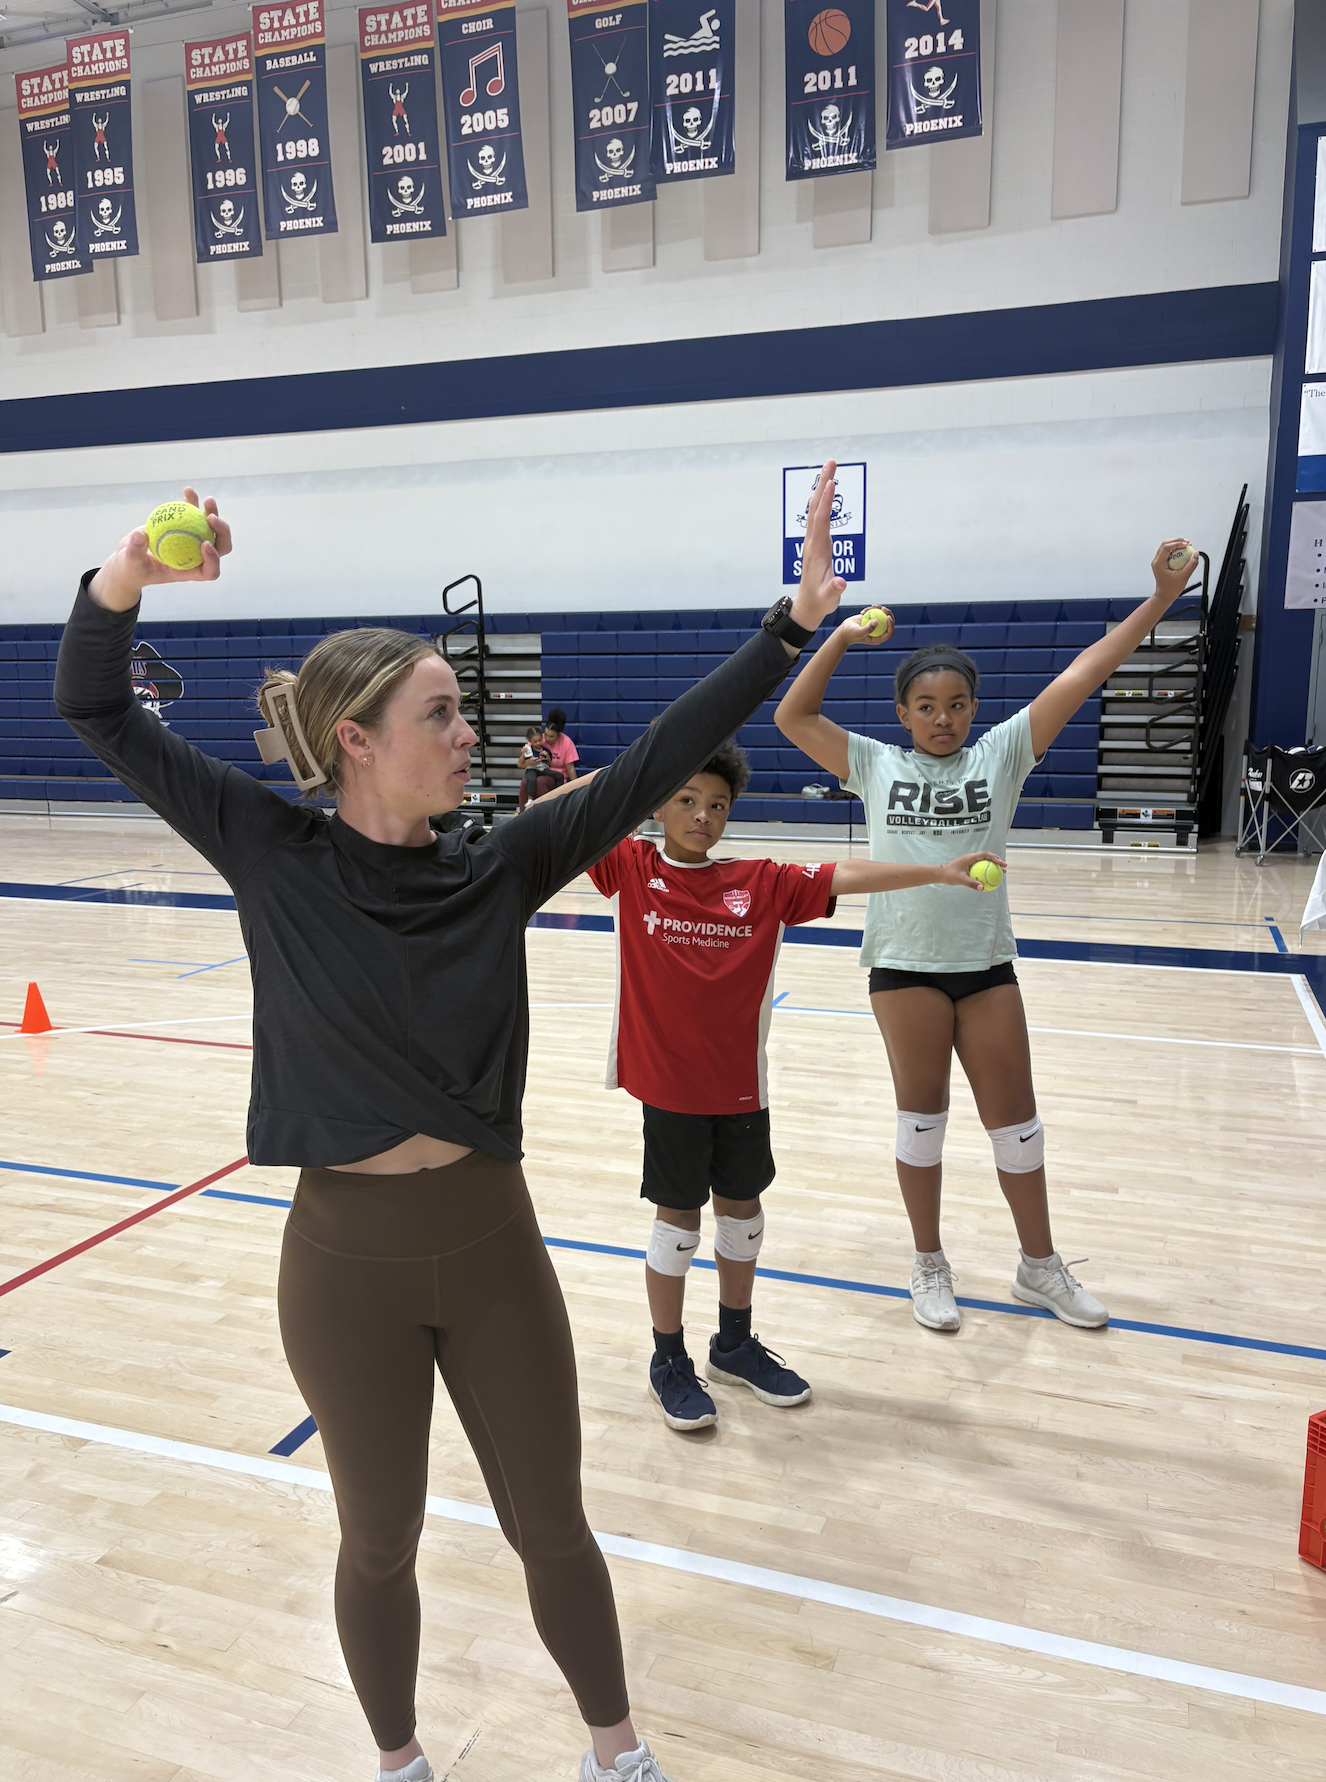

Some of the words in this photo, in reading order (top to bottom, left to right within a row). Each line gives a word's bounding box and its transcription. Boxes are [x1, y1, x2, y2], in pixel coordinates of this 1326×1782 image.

[258, 1, 319, 30] STATE
[365, 5, 428, 32] STATE
[595, 14, 622, 29] GOLF
[258, 22, 322, 44] CHAMPIONS
[364, 24, 431, 46] CHAMPIONS
[461, 18, 494, 34] CHOIR
[71, 39, 126, 64] STATE
[190, 39, 248, 66] STATE
[904, 29, 964, 59] 2014
[71, 58, 128, 78] CHAMPIONS
[190, 58, 250, 79] CHAMPIONS
[266, 51, 316, 71] BASEBALL
[369, 55, 428, 74] WRESTLING
[666, 68, 717, 96] 2011
[804, 66, 858, 94] 2011
[21, 89, 69, 109] CHAMPION
[75, 86, 126, 103] WRESTLING
[194, 86, 248, 104] WRESTLING
[460, 108, 509, 135] 2005
[589, 102, 639, 129] 2007
[906, 116, 963, 135] PHOENIX
[276, 138, 320, 162] 1998
[382, 142, 427, 165] 2001
[665, 157, 718, 174] PHOENIX
[804, 153, 858, 170] PHOENIX
[86, 166, 124, 189] 1995
[206, 168, 247, 189] 1996
[40, 190, 74, 213] 1988
[466, 193, 513, 209] PHOENIX
[592, 185, 641, 202] PHOENIX
[280, 217, 323, 231] PHOENIX
[386, 221, 431, 234] PHOENIX
[89, 240, 127, 253] PHOENIX
[210, 241, 249, 255] PHOENIX
[45, 259, 81, 273] PHOENIX
[152, 513, 175, 527] PRIX
[888, 779, 991, 814] RISE
[889, 816, 960, 826] VOLLEYBALL
[663, 918, 752, 937] PROVIDENCE
[663, 933, 690, 945] Sports
[692, 937, 729, 948] Medicine
